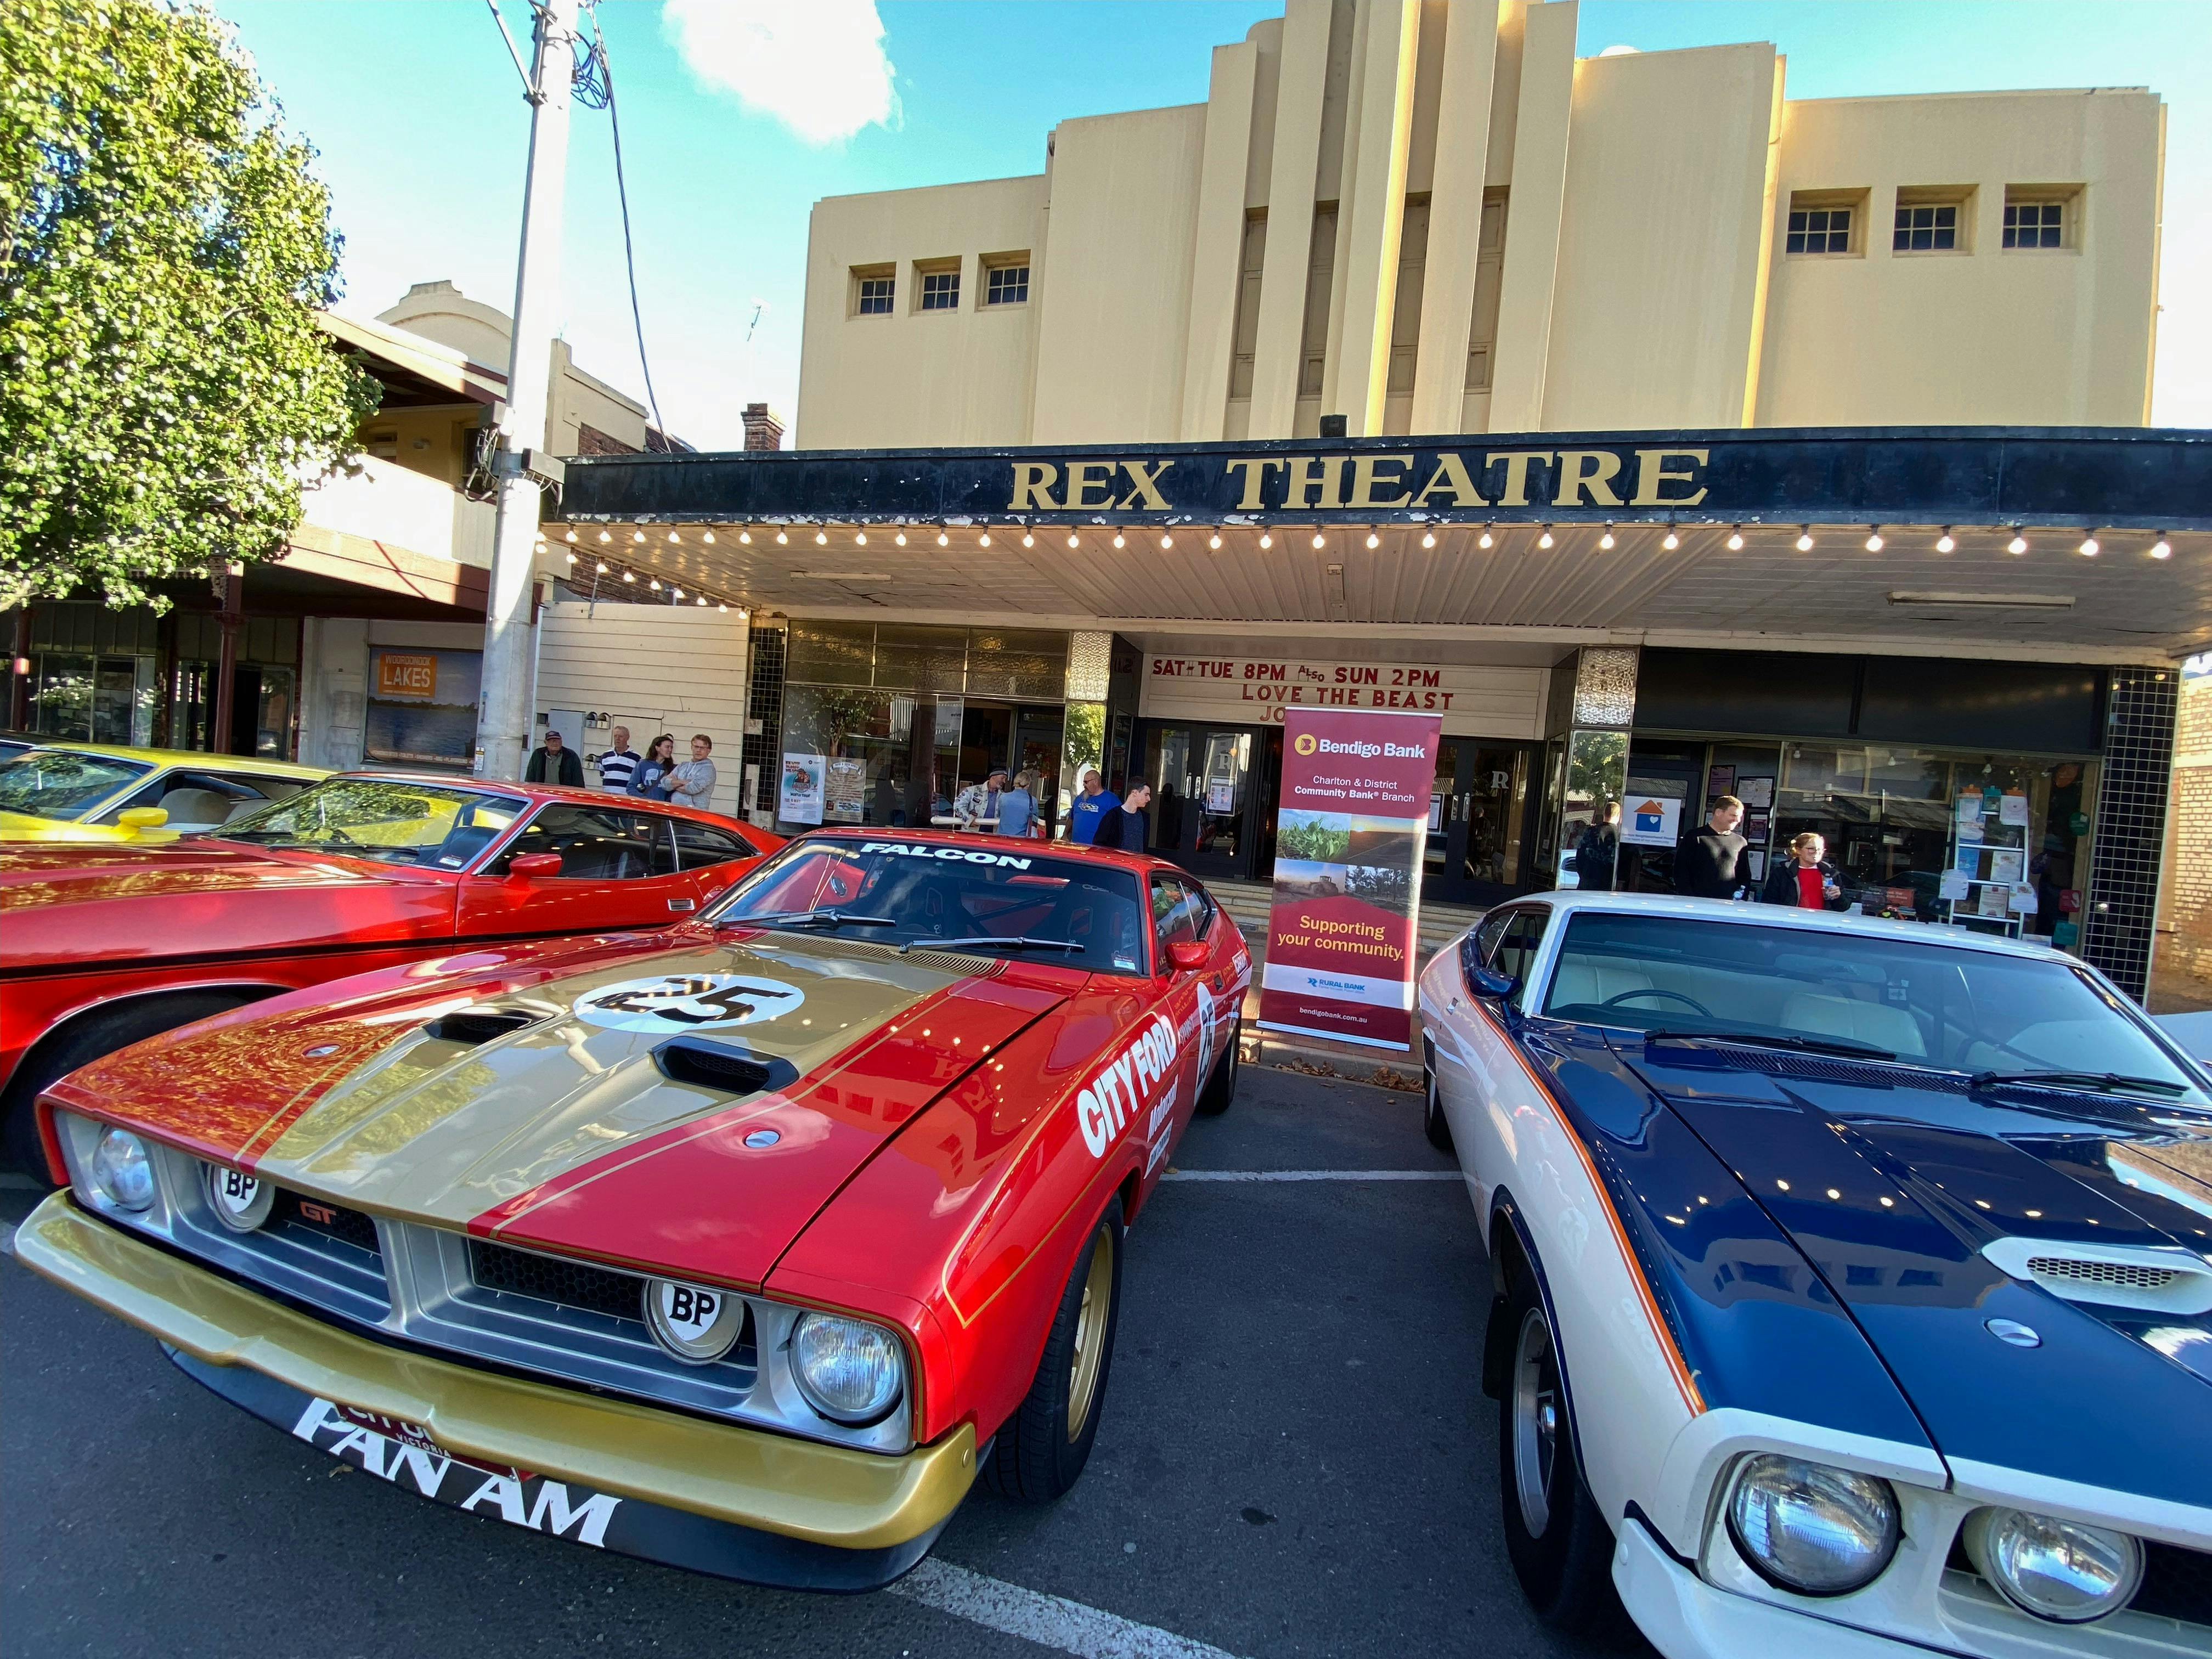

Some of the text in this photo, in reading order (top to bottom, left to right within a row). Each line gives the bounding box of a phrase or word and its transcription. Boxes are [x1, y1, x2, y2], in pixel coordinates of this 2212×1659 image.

[1007, 449, 1709, 511] REX THEATRE
[383, 665, 431, 688] LAKES
[1244, 663, 1286, 681] 8PM
[1298, 665, 1325, 682] ALSO
[1334, 667, 1379, 685] SUN
[1391, 668, 1440, 687] 2PM
[1242, 684, 1454, 710] LOVE THE BEAST
[1319, 739, 1425, 759] Bendigo Bank
[1313, 775, 1398, 789] Charlton & District
[1491, 770, 1509, 789] R
[1294, 786, 1347, 799] Community
[1381, 792, 1415, 803] Branch
[860, 843, 1032, 870] FALCON
[1299, 915, 1386, 941] Supporting
[1277, 933, 1404, 961] your community.
[1319, 979, 1344, 988] RURAL
[1344, 983, 1365, 991] BANK
[585, 978, 794, 1024] 25
[1299, 1007, 1368, 1023] bendigobank.com.au
[1077, 1050, 1138, 1159] CITY
[1131, 1014, 1177, 1098] FORD
[225, 1170, 256, 1200] BP
[300, 1201, 338, 1224] GT
[668, 1285, 715, 1327] BP
[396, 1432, 452, 1458] VICTORIA
[292, 1397, 453, 1498] PAN
[460, 1474, 624, 1548] AM
